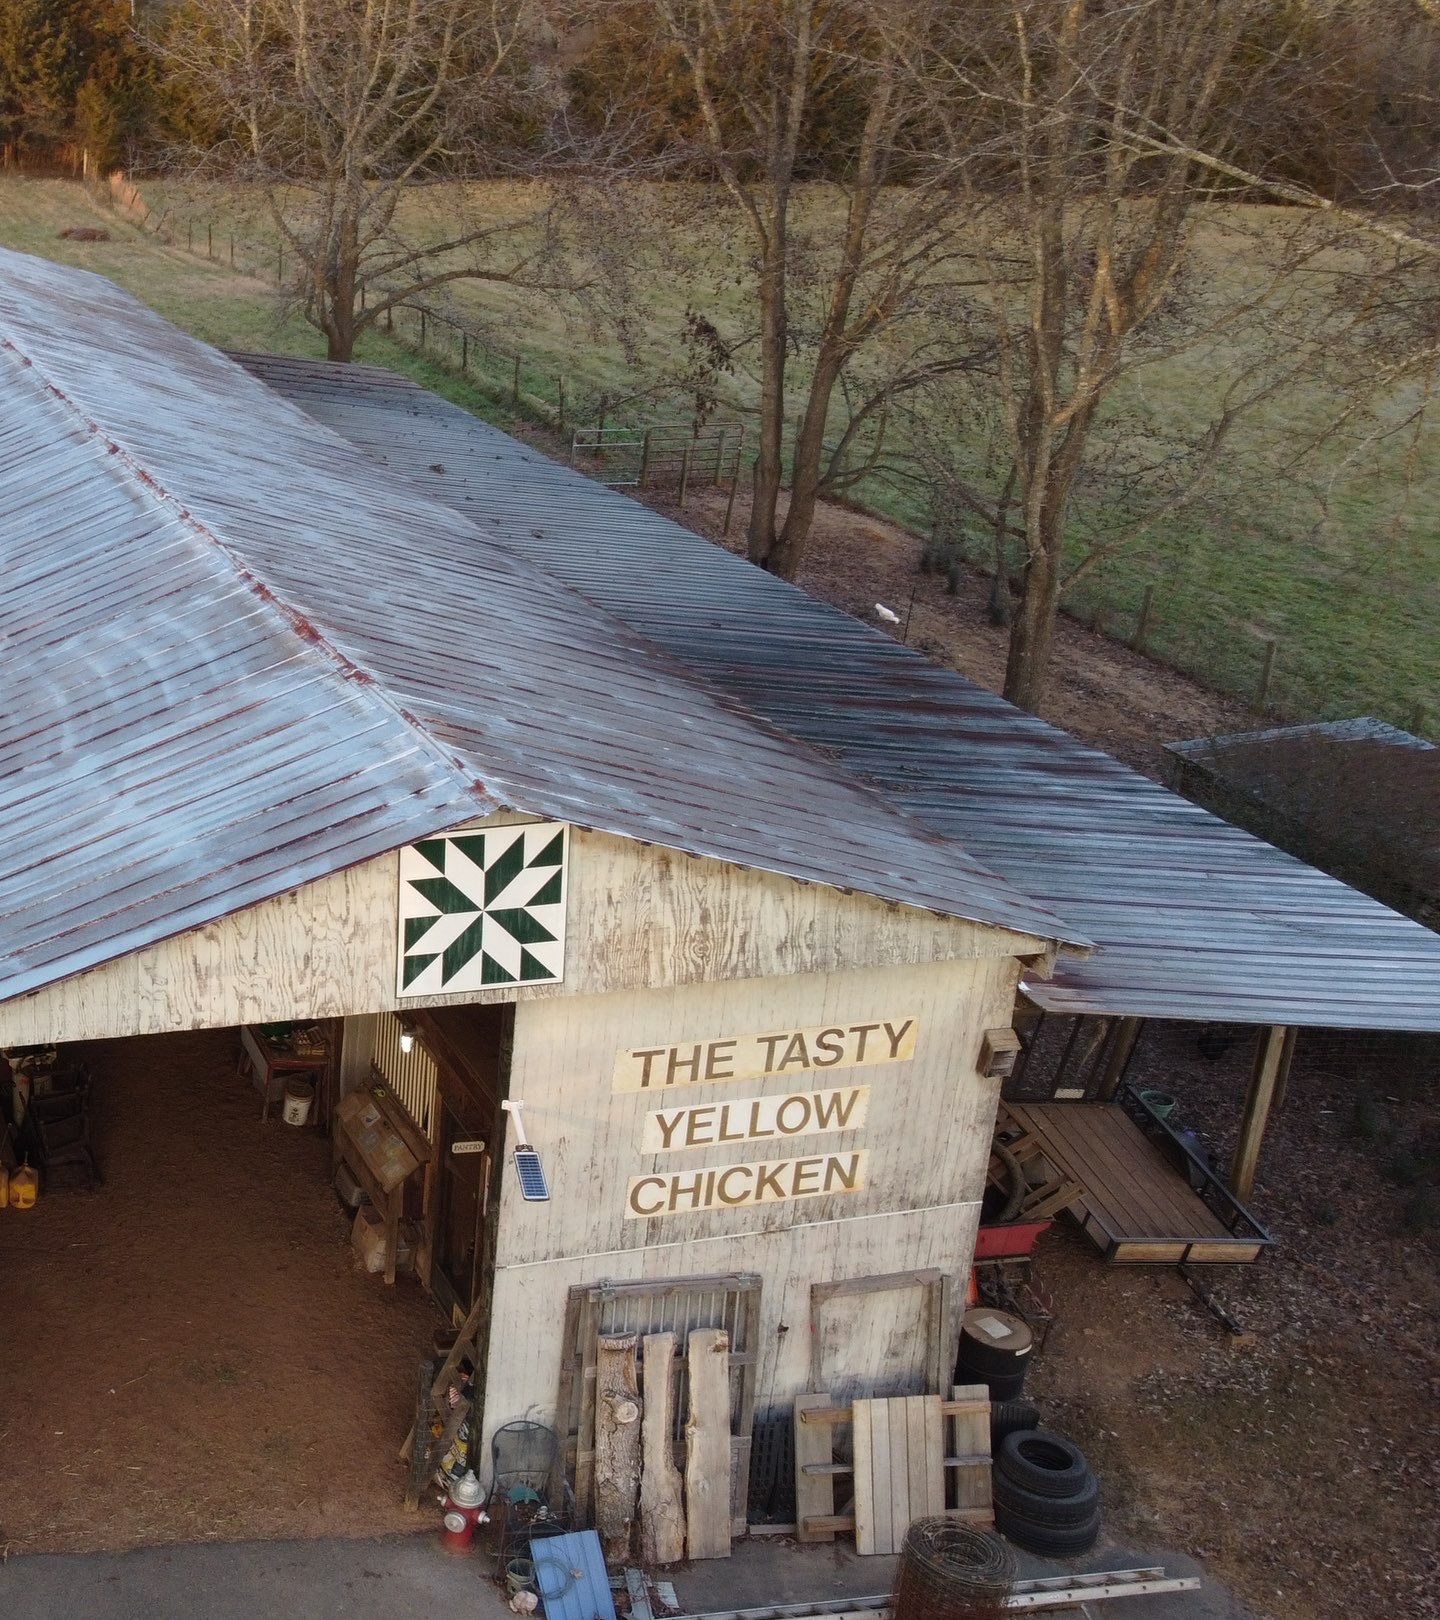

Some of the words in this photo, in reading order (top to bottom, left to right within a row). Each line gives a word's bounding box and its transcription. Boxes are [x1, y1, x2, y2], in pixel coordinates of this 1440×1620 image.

[632, 1040, 737, 1087] THE
[756, 1019, 913, 1073] TASTY
[454, 1143, 483, 1151] PANTRY
[654, 1089, 861, 1149] YELLOW
[629, 1153, 861, 1216] CHICKEN
